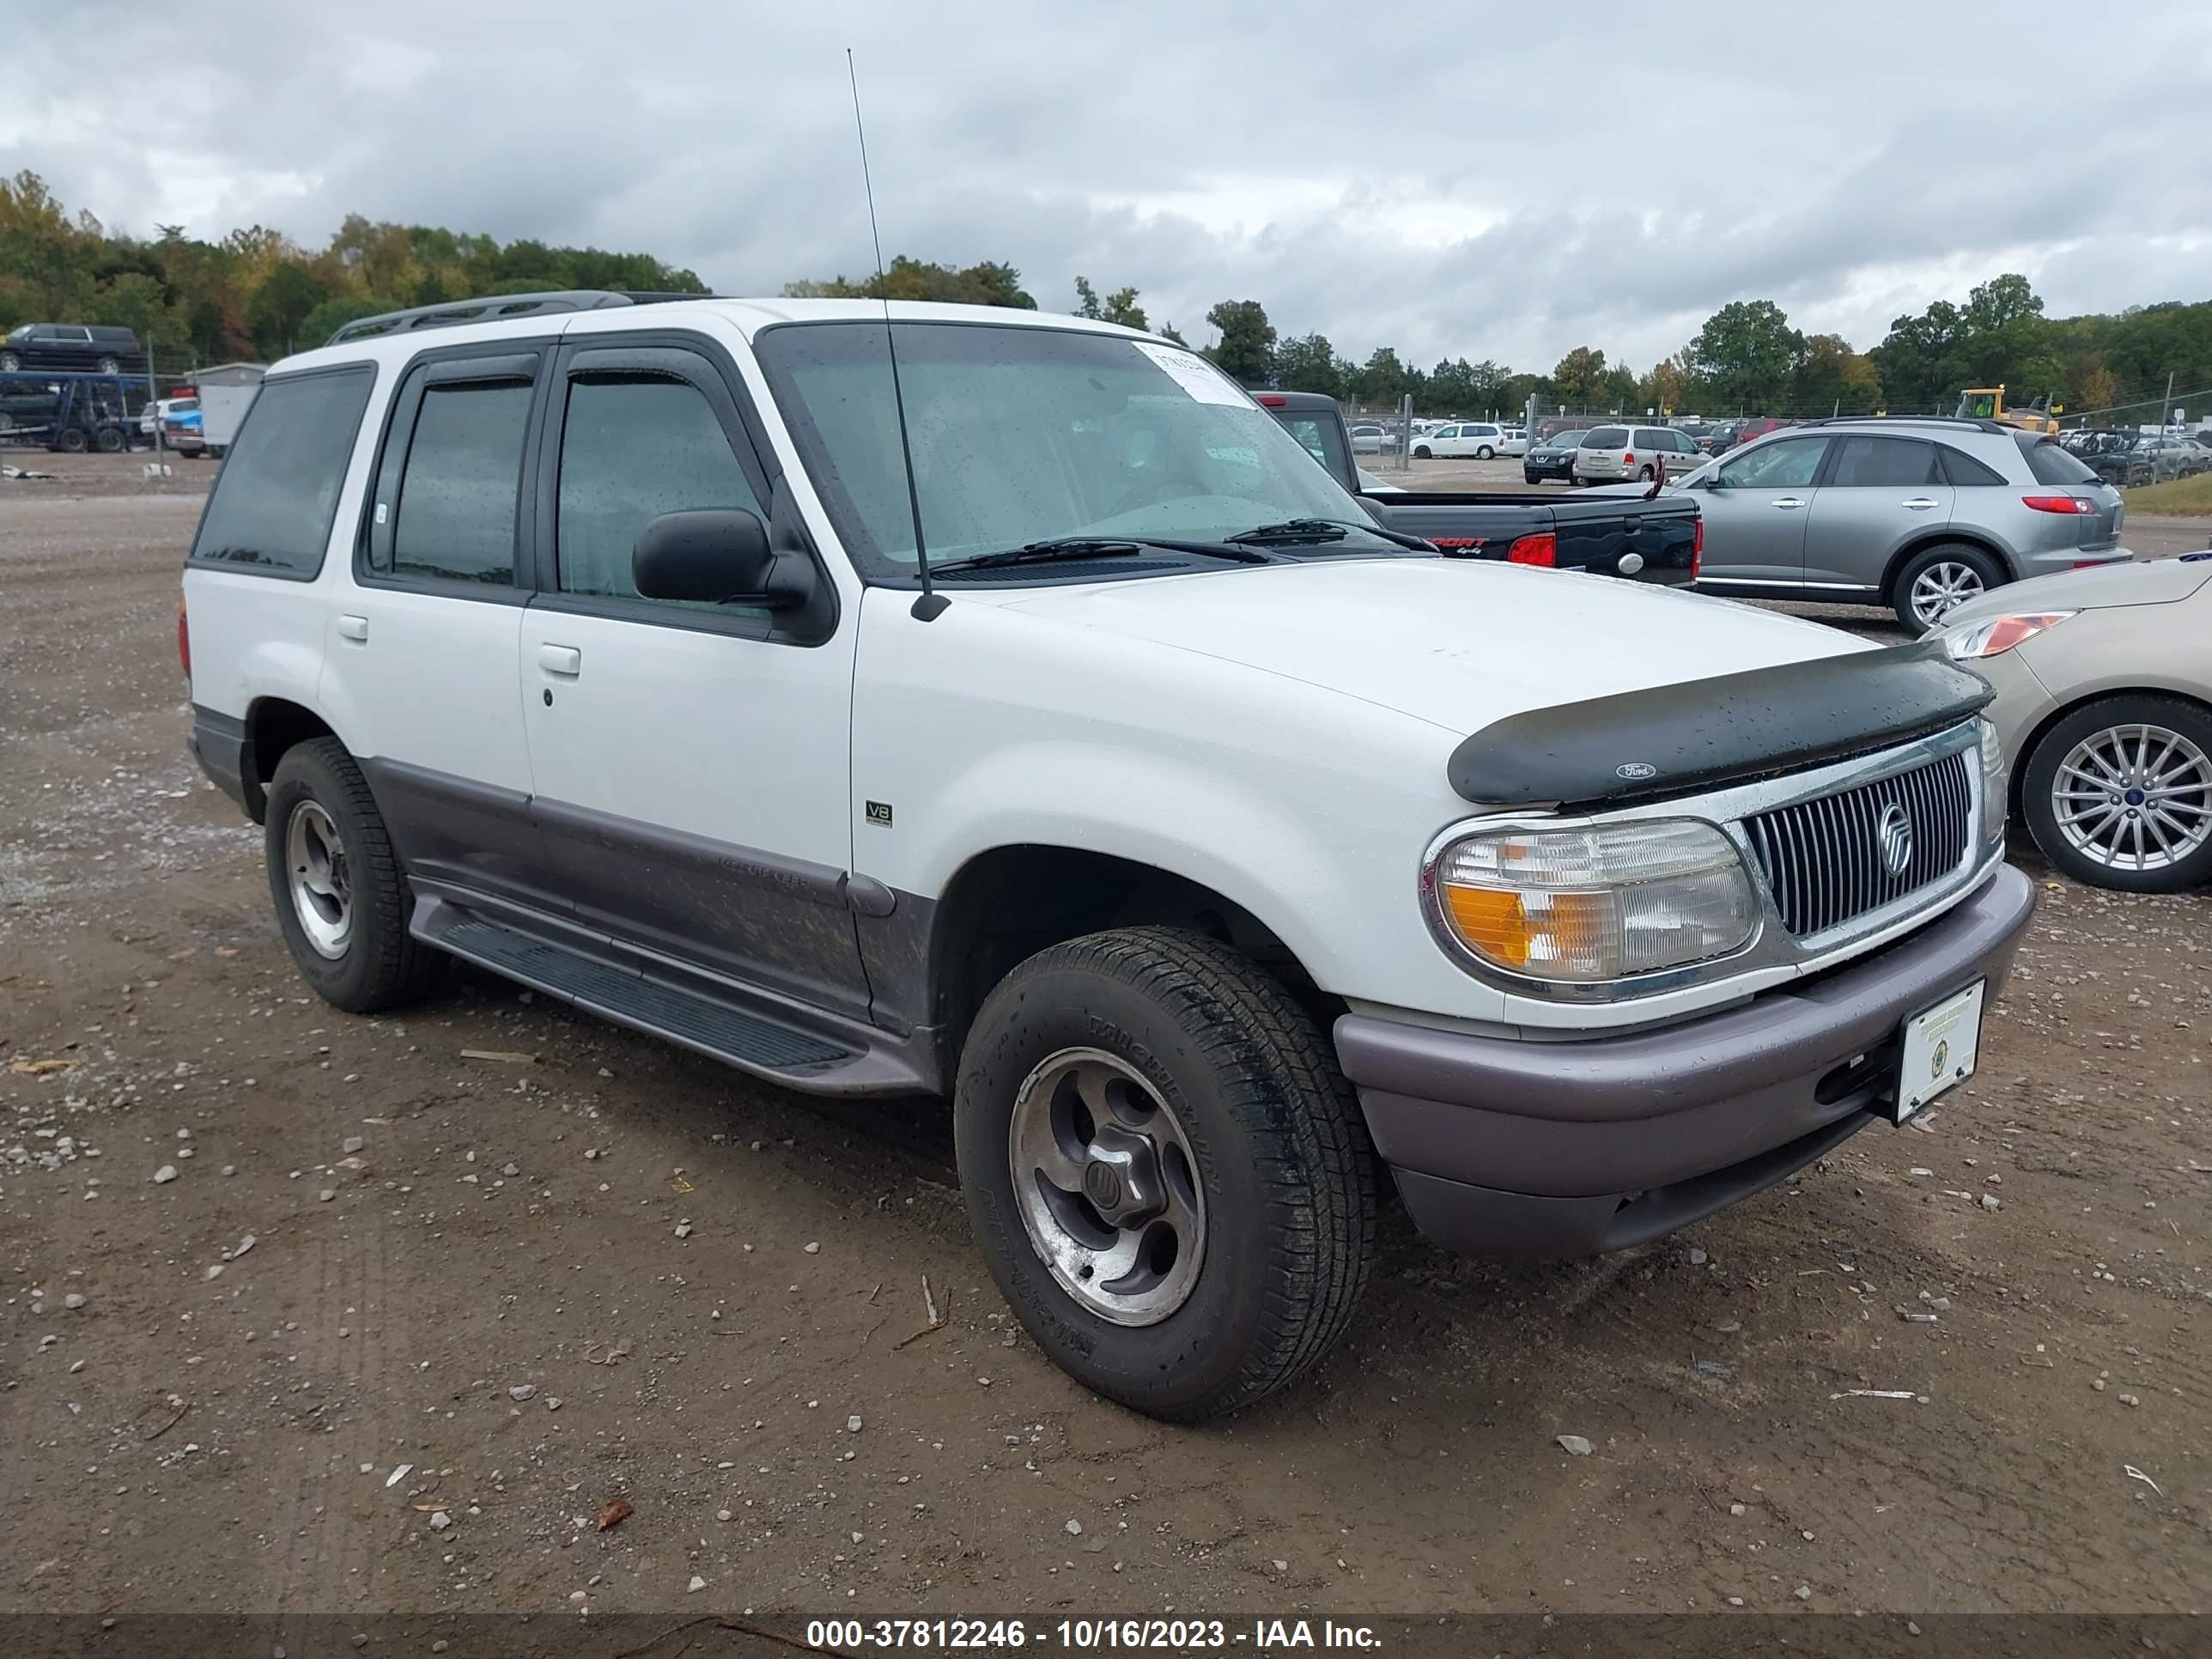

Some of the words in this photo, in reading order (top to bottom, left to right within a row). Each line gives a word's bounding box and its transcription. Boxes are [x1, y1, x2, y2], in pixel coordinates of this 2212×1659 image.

[1427, 536, 1490, 547] PORT
[1624, 764, 1650, 777] Ford
[868, 803, 890, 819] V8
